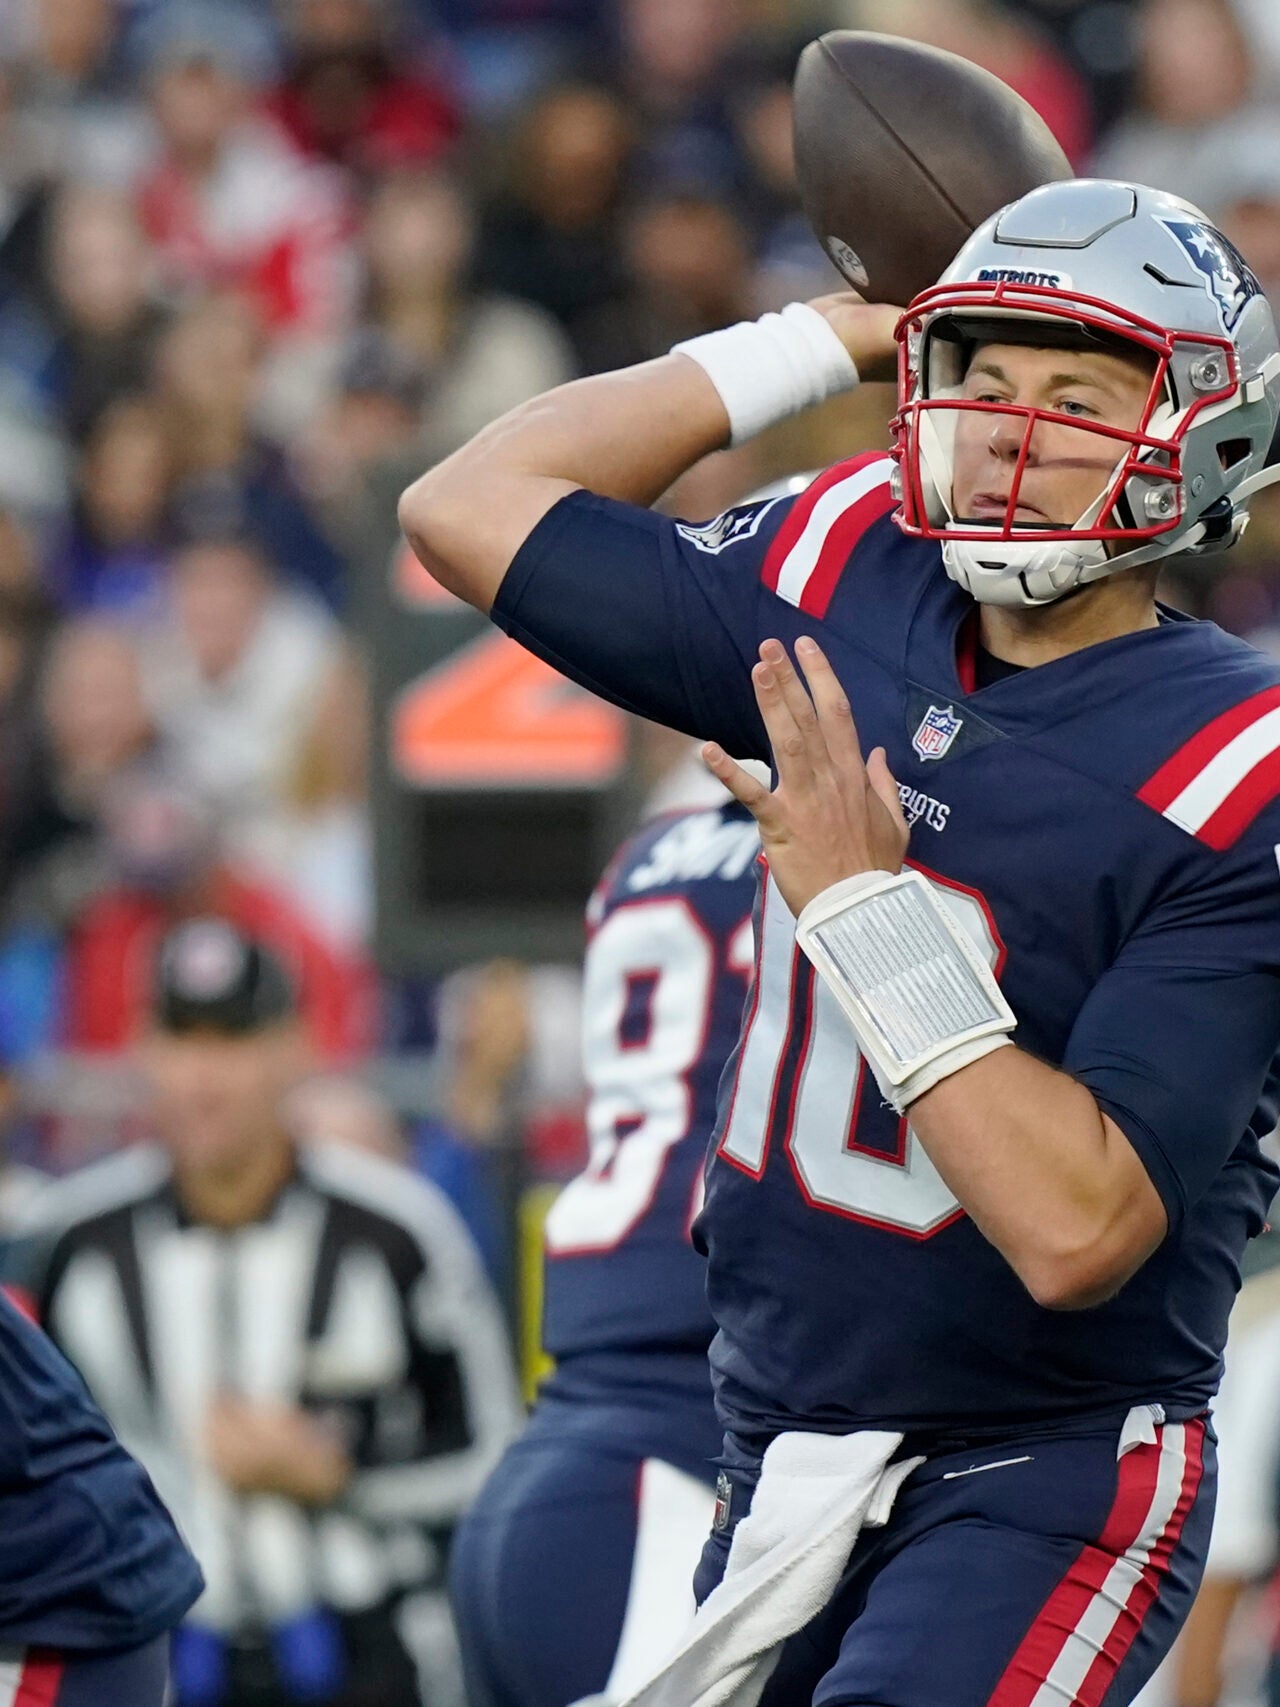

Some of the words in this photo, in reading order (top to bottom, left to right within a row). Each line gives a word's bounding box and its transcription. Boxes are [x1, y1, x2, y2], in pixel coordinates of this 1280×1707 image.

[977, 268, 1061, 290] PATRIOTS
[917, 725, 945, 752] NFL
[896, 780, 952, 832] RIOTS
[717, 852, 1007, 1241] 10
[545, 896, 753, 1259] 8
